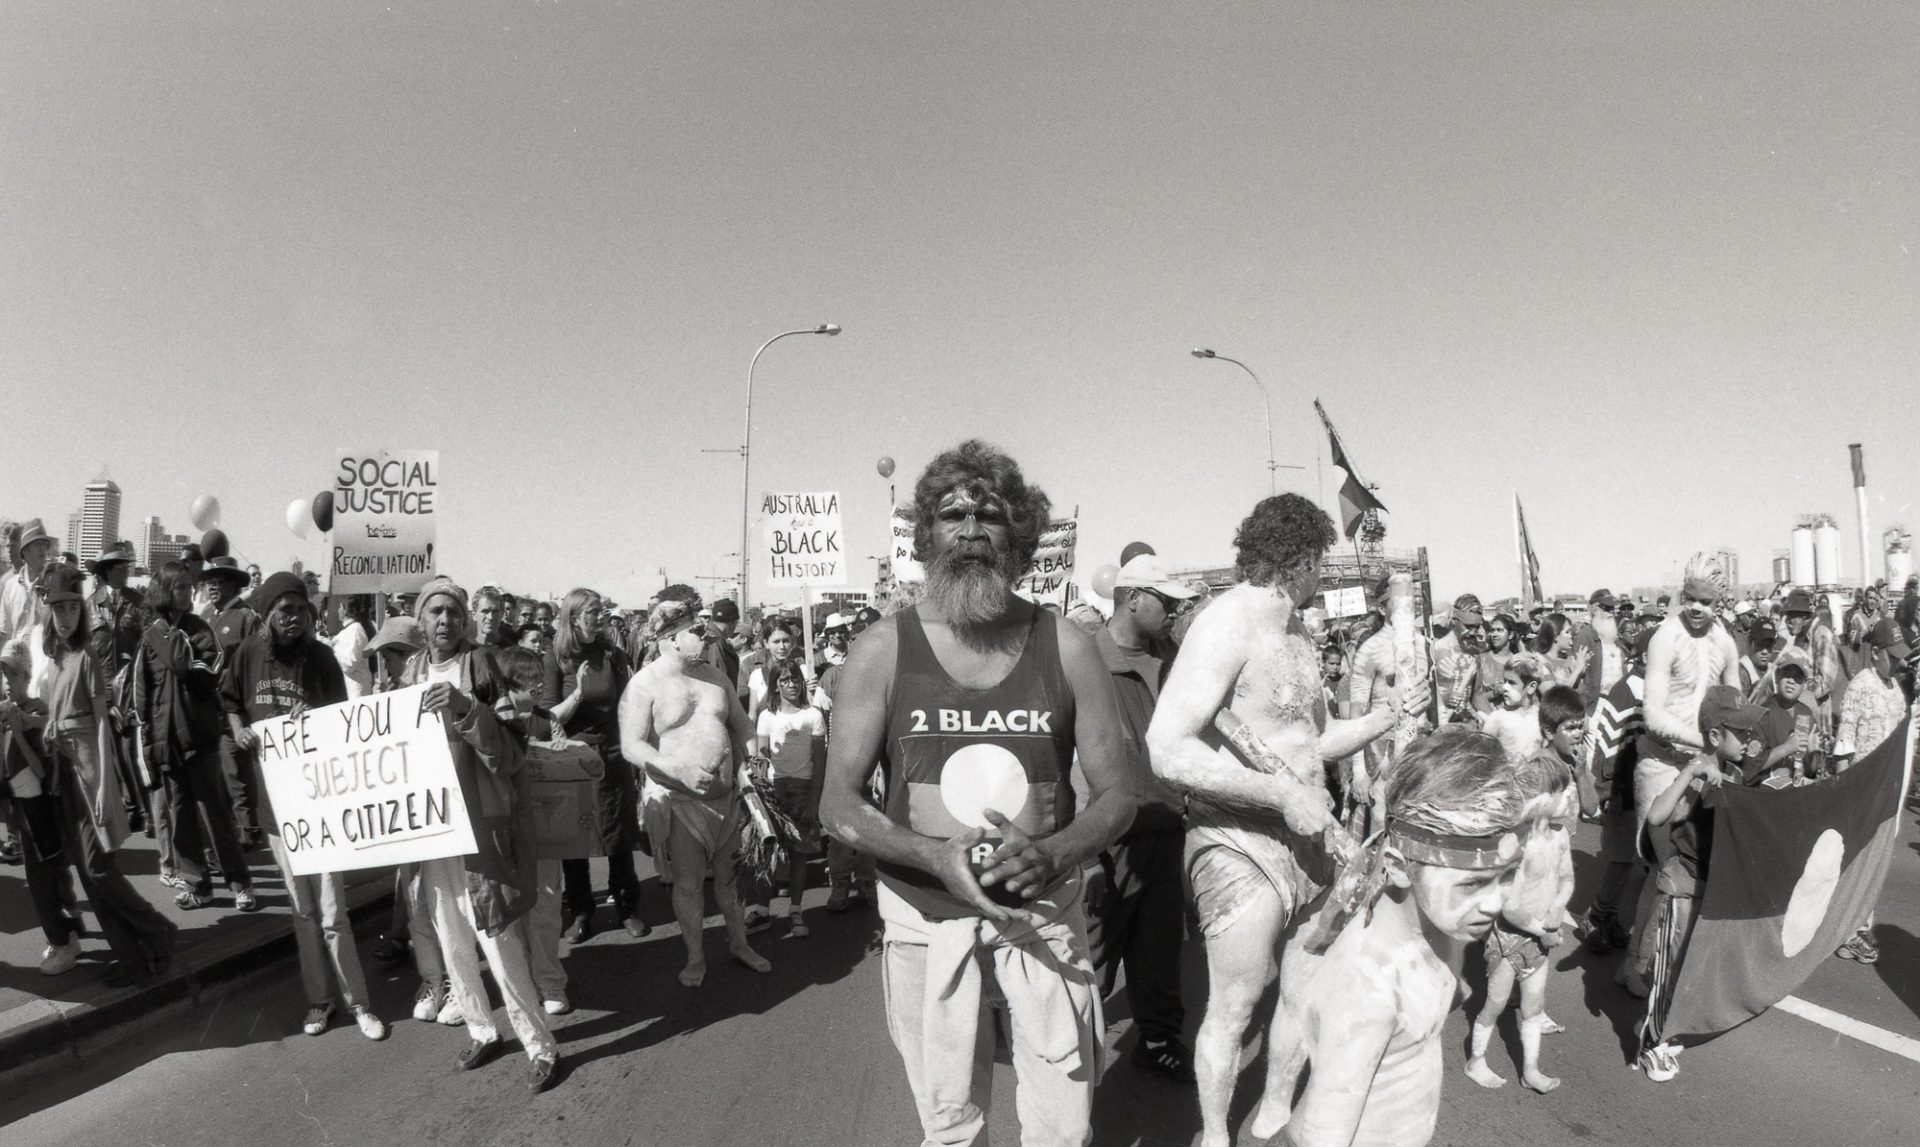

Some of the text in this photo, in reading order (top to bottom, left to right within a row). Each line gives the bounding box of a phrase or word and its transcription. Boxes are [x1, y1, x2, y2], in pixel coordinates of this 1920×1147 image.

[337, 457, 437, 488] SOCIAL
[335, 487, 433, 514] JUSTICE
[761, 493, 838, 516] AUSTRALIA
[770, 530, 839, 554] BLACK
[771, 555, 836, 578] HISTORY
[1032, 552, 1073, 573] RBAL
[1031, 577, 1063, 594] LAW
[263, 715, 317, 762] ARE
[340, 697, 391, 743] YOU
[910, 708, 1052, 733] 2 BLACK
[303, 741, 410, 800] SUBJECT
[282, 787, 450, 852] OR A CITIZEN
